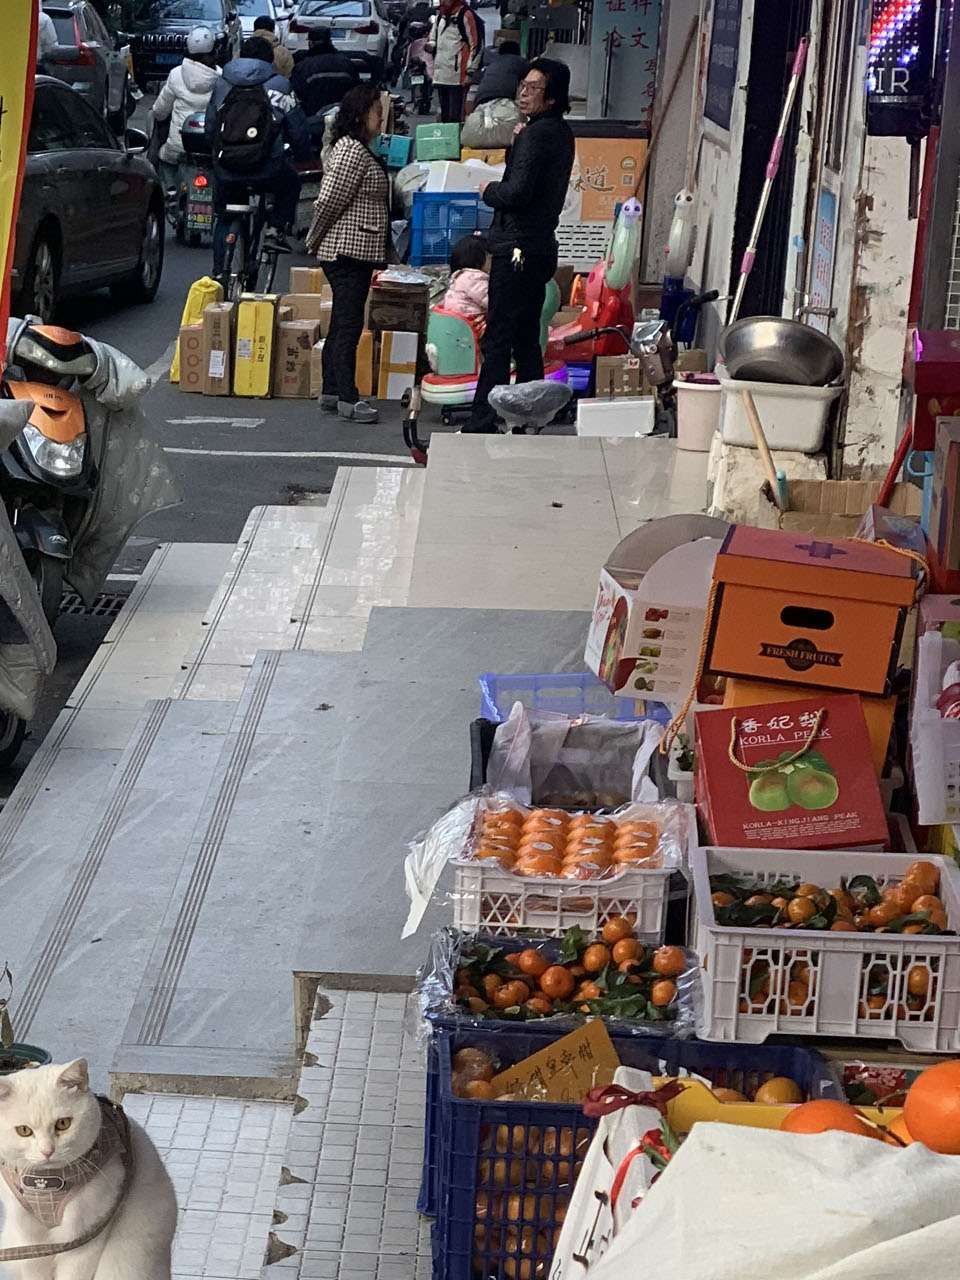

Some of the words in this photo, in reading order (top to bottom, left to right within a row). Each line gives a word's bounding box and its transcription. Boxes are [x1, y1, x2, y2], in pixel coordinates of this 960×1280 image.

[766, 647, 798, 659] FRESH
[799, 651, 836, 664] FRUITS
[739, 733, 785, 745] KORLA
[793, 728, 831, 740] PEK
[833, 812, 858, 820] PEAK
